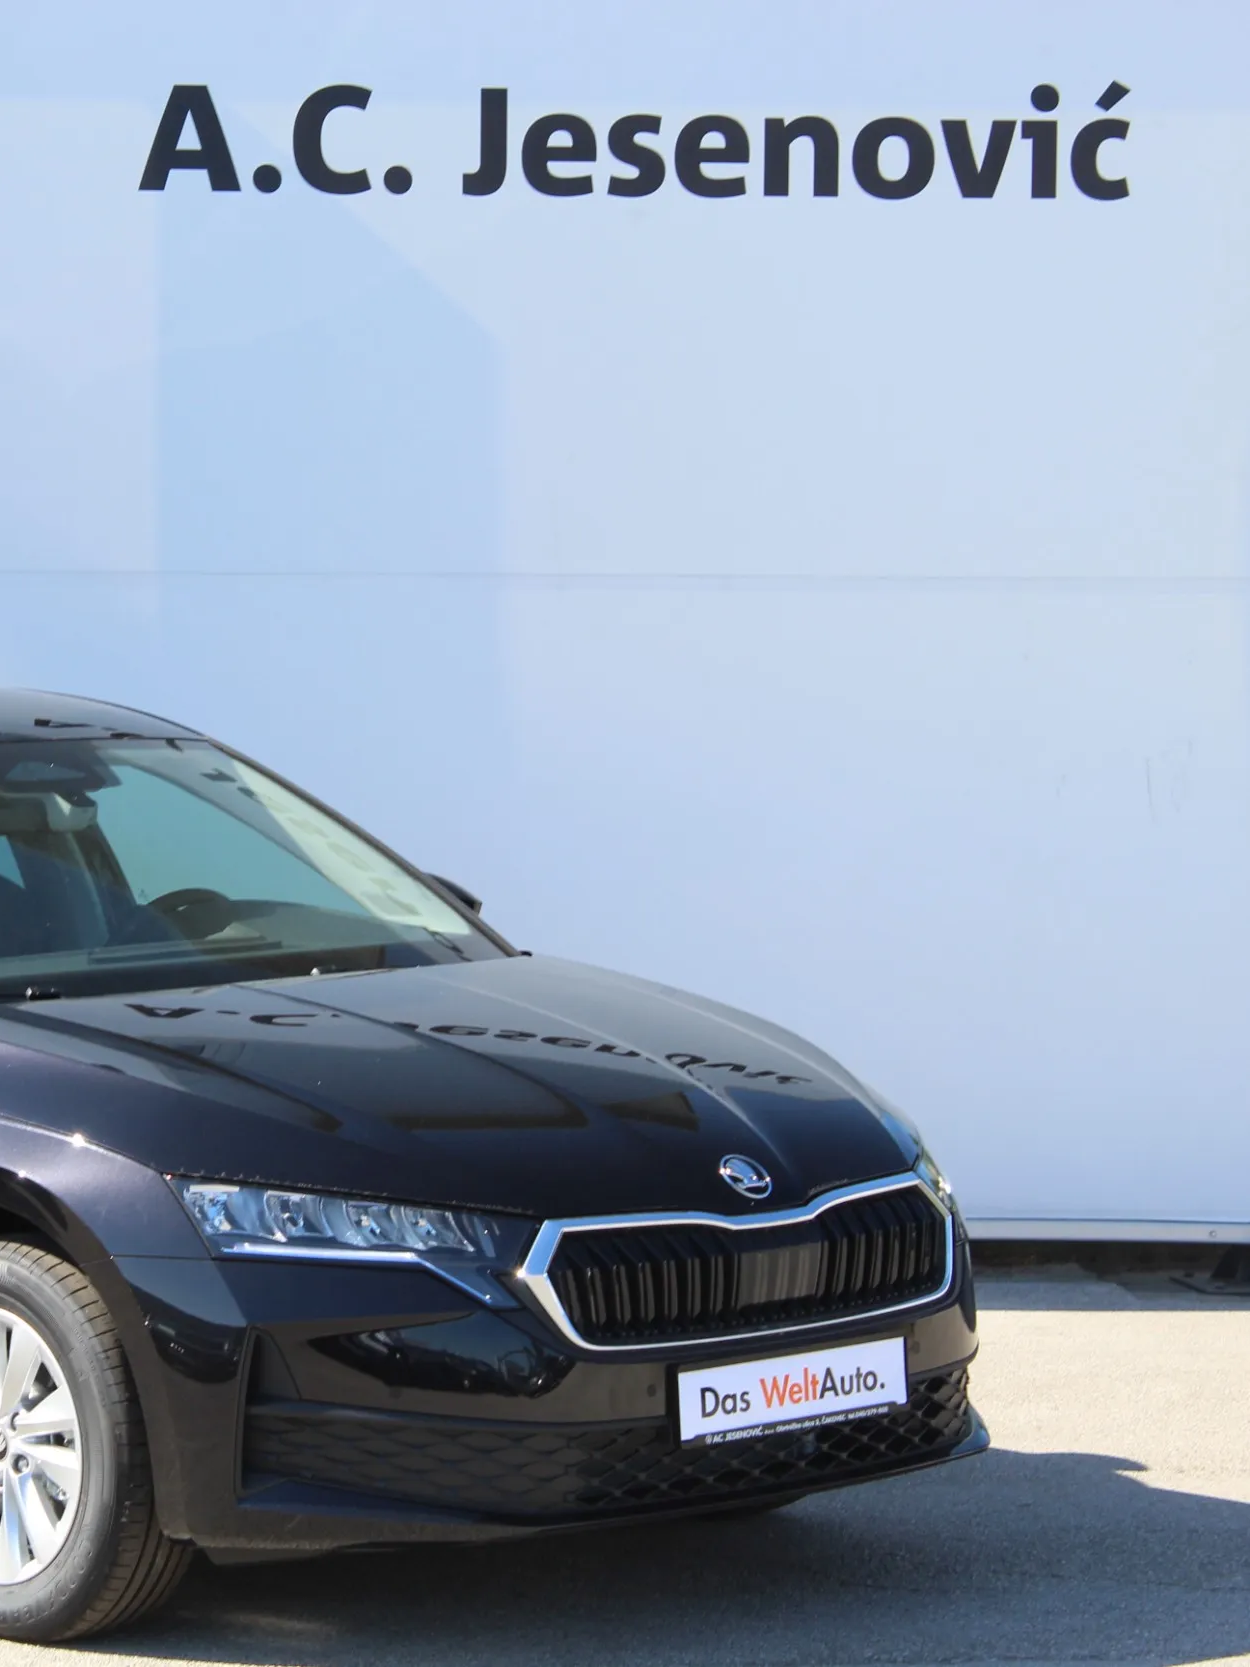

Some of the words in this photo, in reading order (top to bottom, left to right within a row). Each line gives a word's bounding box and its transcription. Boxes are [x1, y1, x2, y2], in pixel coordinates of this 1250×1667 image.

[138, 82, 412, 195] A.C.
[461, 79, 1131, 202] Jesenović
[700, 1386, 751, 1419] Das
[759, 1366, 886, 1409] WeltAuto.
